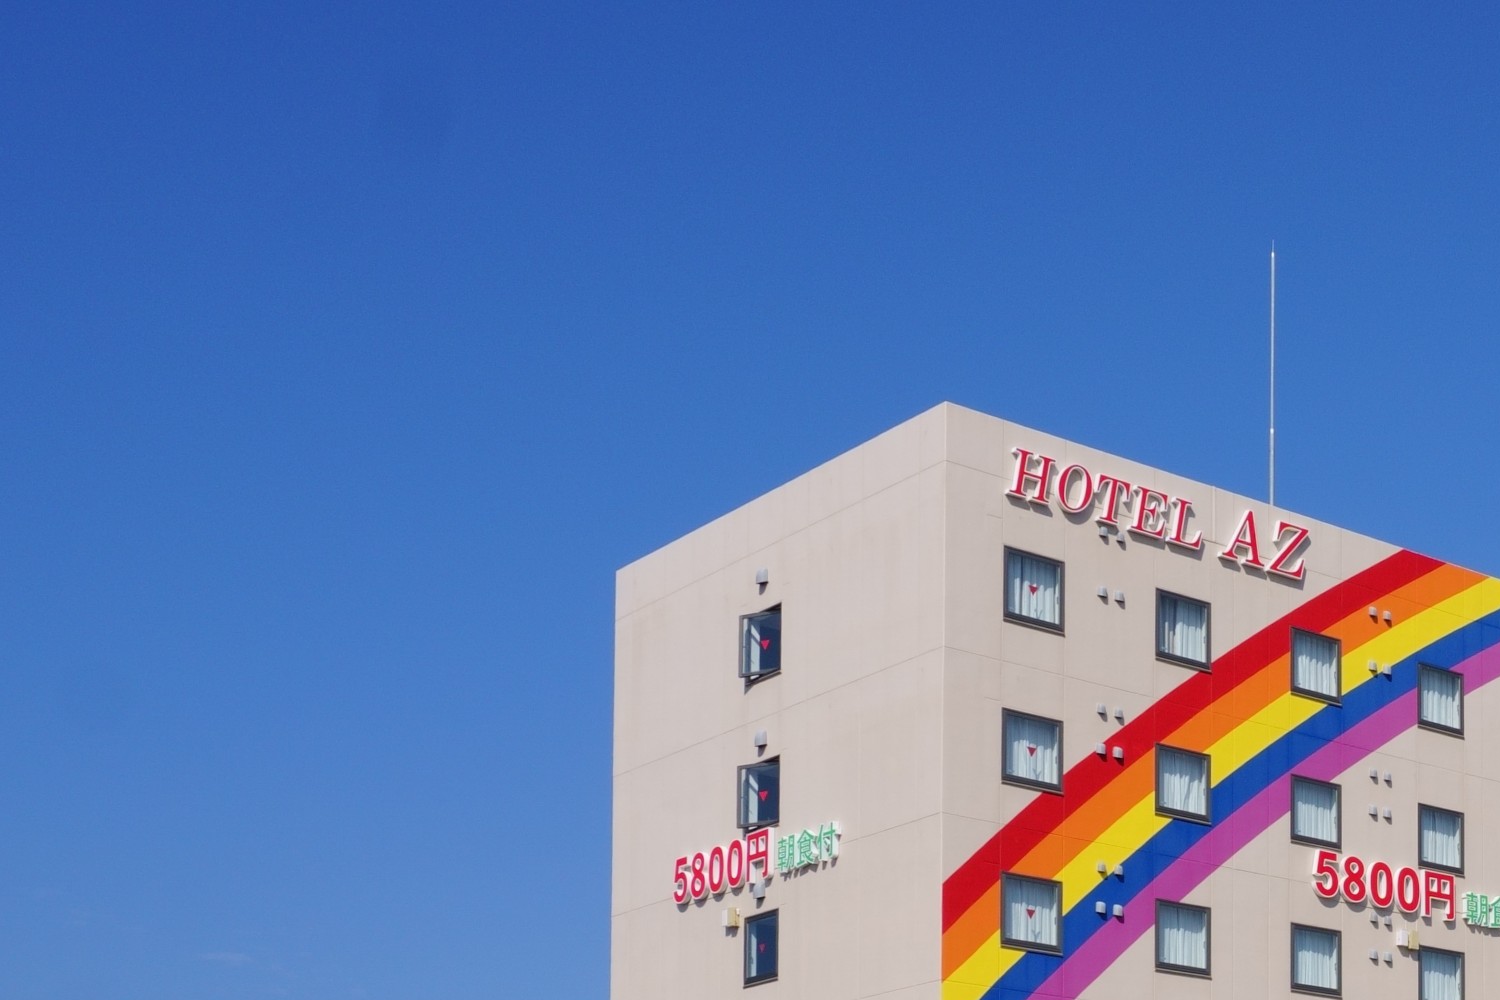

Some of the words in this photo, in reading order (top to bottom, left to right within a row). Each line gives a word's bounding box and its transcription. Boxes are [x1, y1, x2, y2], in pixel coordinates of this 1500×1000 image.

[1005, 447, 1203, 550] HOTEL
[1217, 509, 1309, 580] AZ
[673, 827, 775, 904] 5800円
[777, 821, 842, 873] 朝食付
[1312, 849, 1457, 922] 5800円
